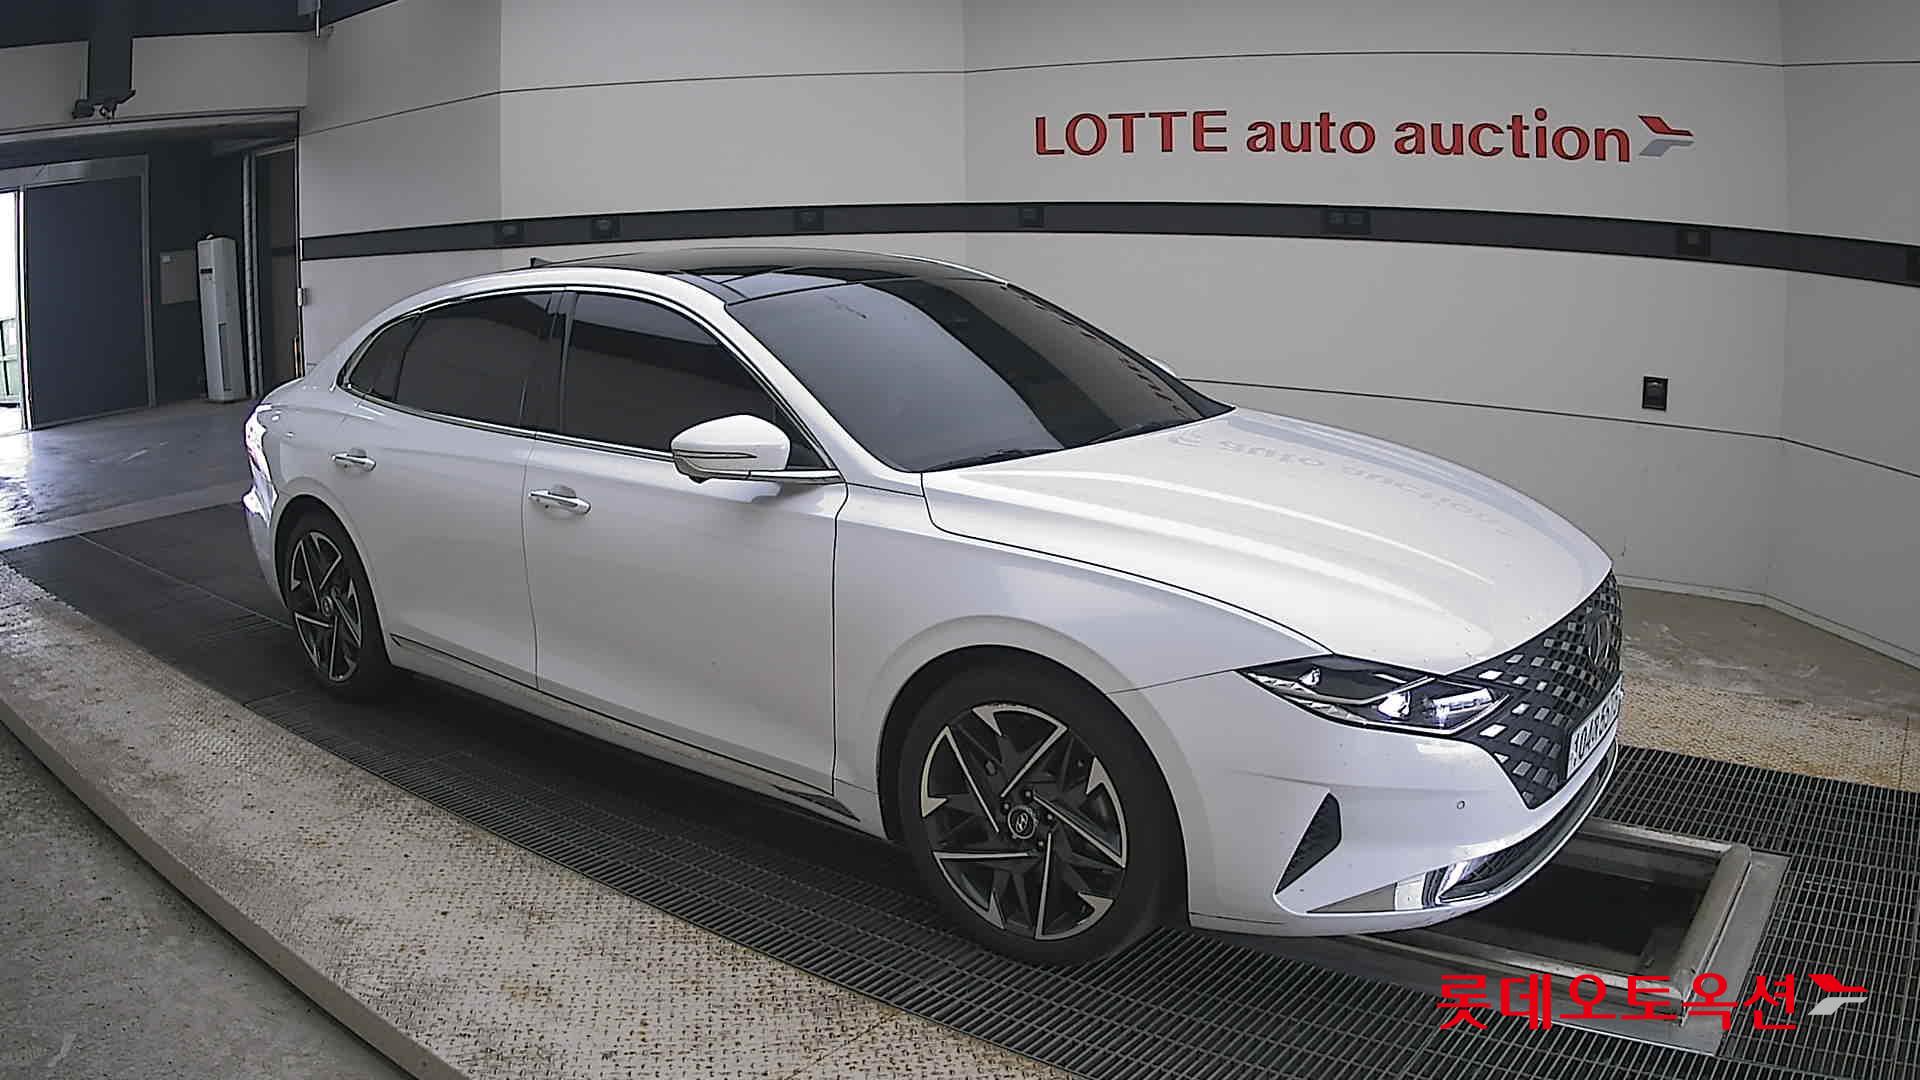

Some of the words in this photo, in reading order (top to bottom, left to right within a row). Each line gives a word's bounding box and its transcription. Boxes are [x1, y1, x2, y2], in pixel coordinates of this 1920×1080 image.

[1034, 110, 1228, 157] LOTTE
[1246, 111, 1376, 155] auto
[1393, 107, 1632, 163] auction
